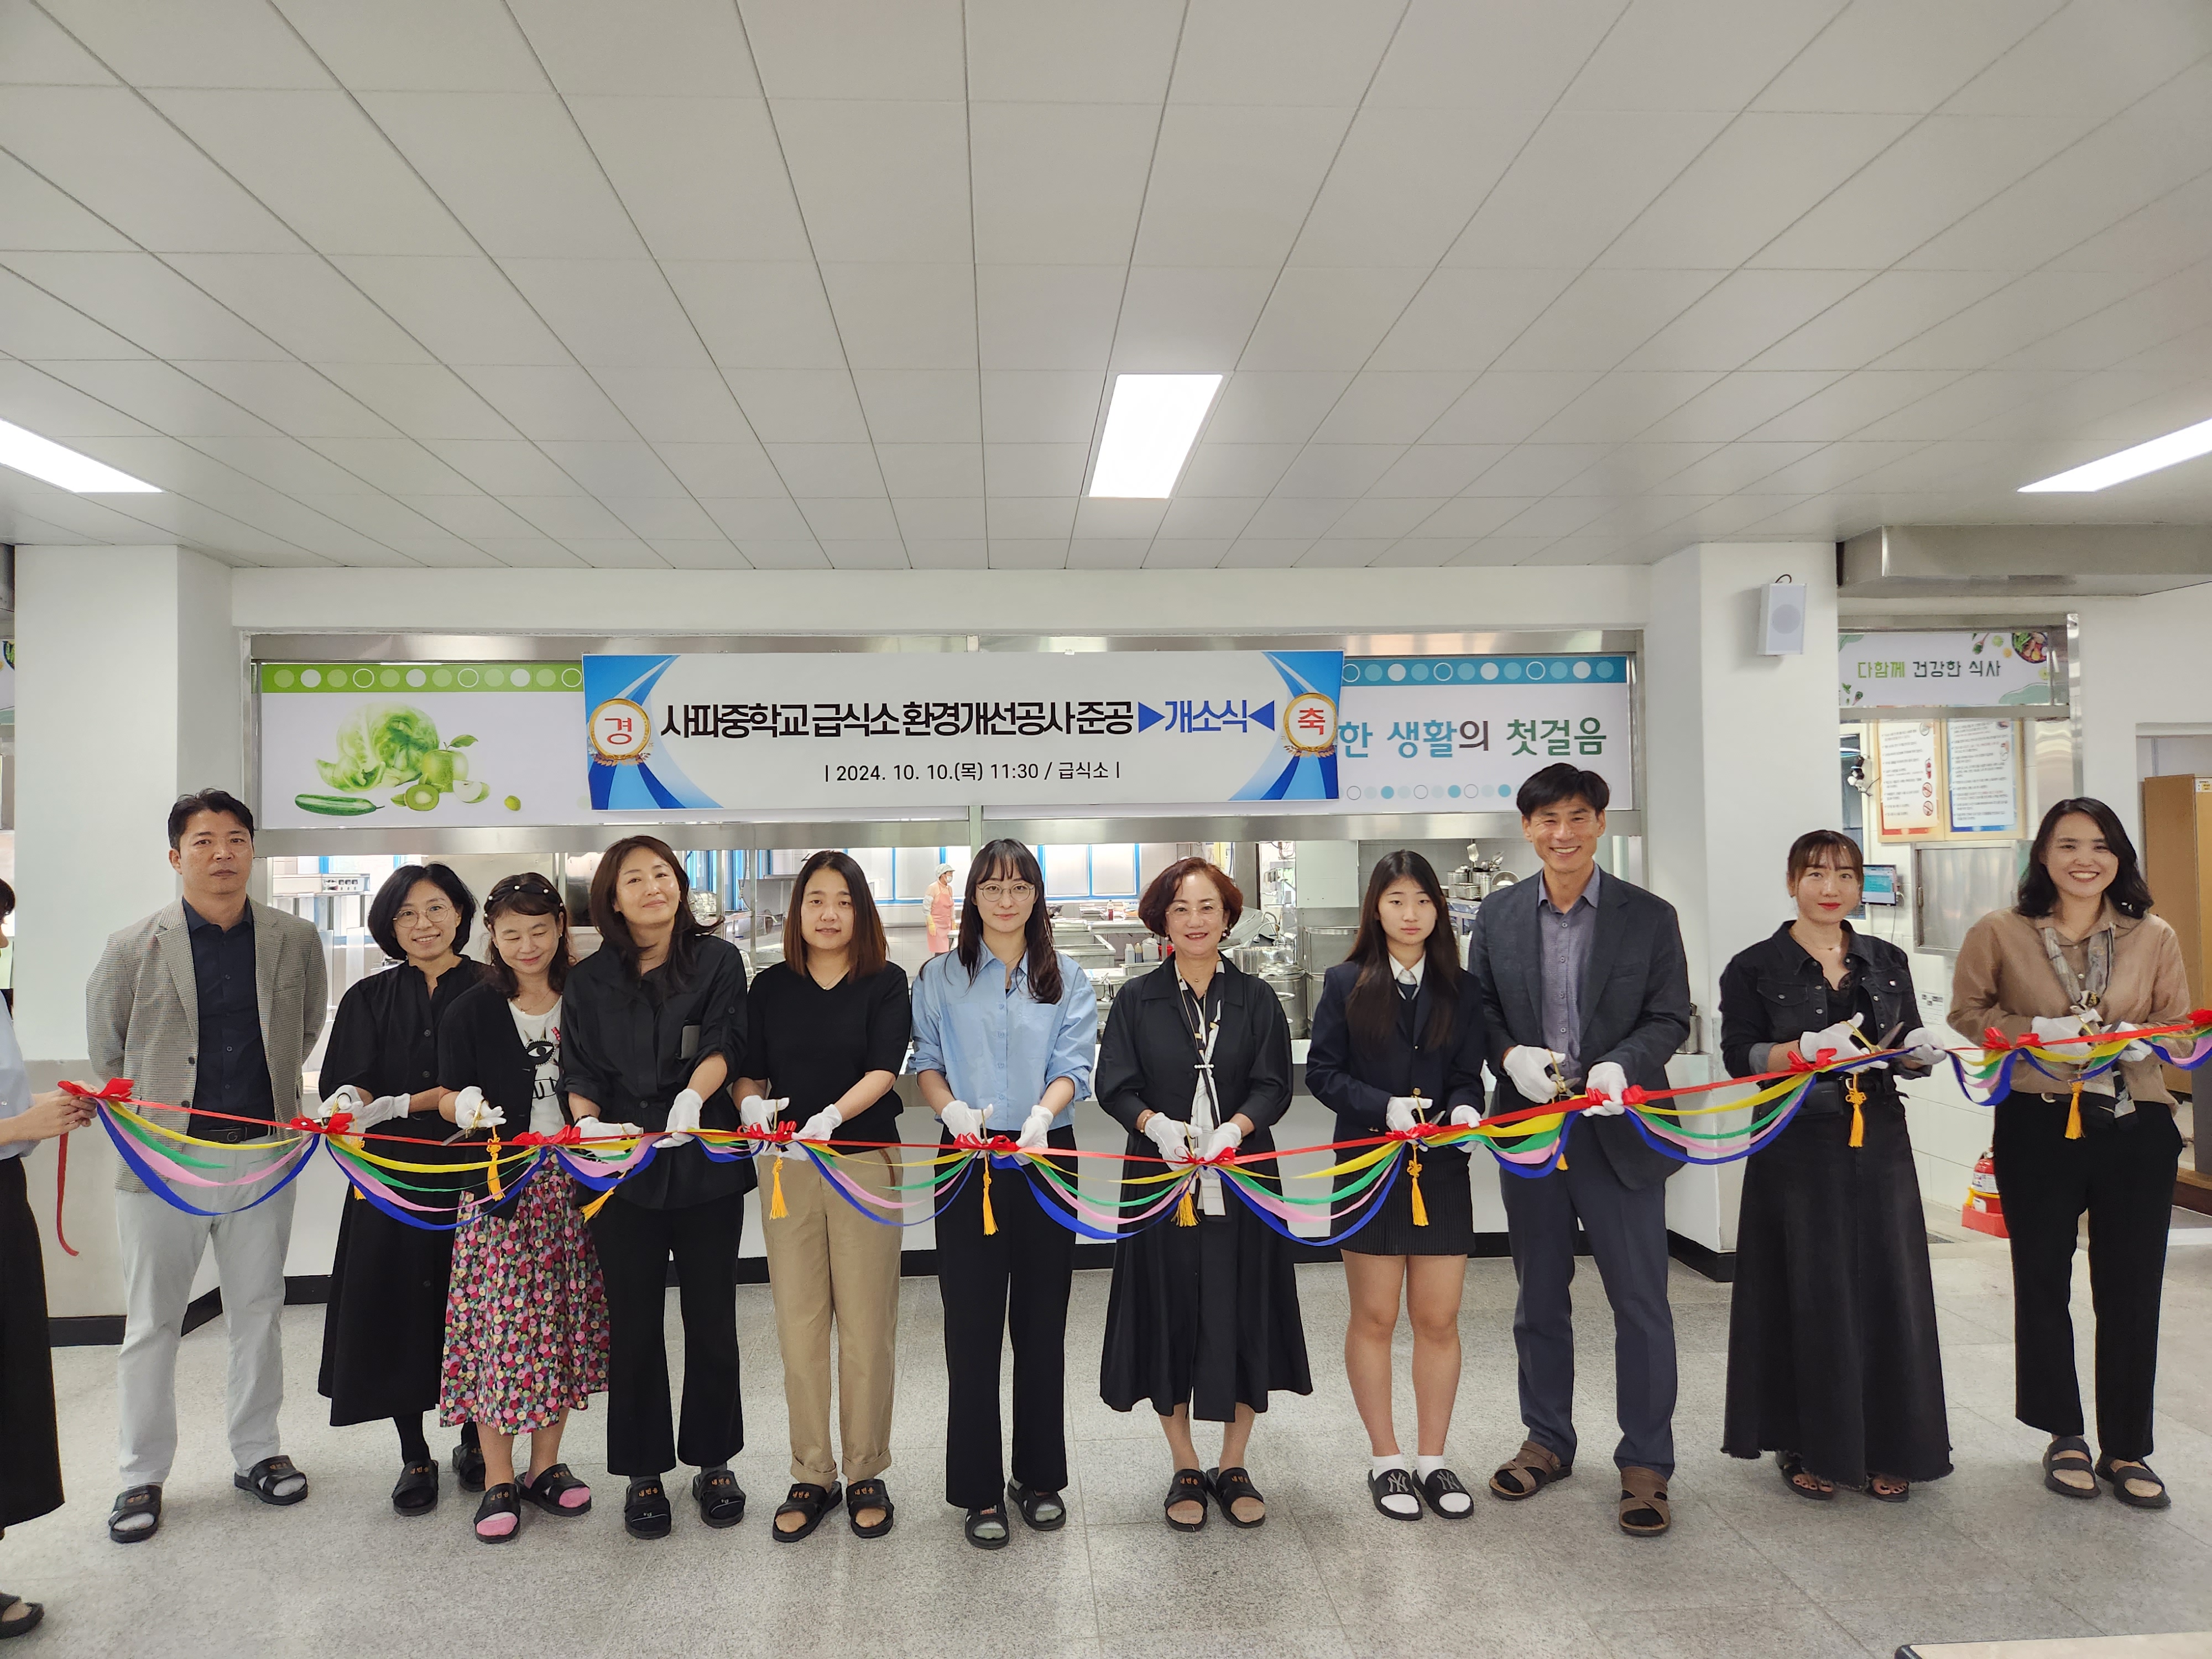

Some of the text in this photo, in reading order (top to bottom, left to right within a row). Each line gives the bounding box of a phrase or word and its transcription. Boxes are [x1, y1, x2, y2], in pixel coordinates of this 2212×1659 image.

[1857, 660, 2001, 679] 다함께 건강한 식사
[660, 702, 810, 738] 사파중학교
[812, 702, 900, 737] 급식소
[902, 701, 1076, 736] 환경개선공사
[1164, 699, 1248, 733] 개소식
[1297, 707, 1326, 735] 축
[604, 718, 633, 744] 경
[1387, 719, 1490, 758] 생활의
[1506, 717, 1608, 756] 첫걸음
[836, 765, 886, 781] 2024.
[894, 765, 920, 780] 10.
[927, 761, 983, 781] 10.(목)
[990, 763, 1039, 779] 11:30
[1058, 761, 1109, 780] 급식소
[854, 1486, 874, 1495] 내빈용
[1387, 1472, 1410, 1493] NY
[1436, 1470, 1460, 1491] NY
